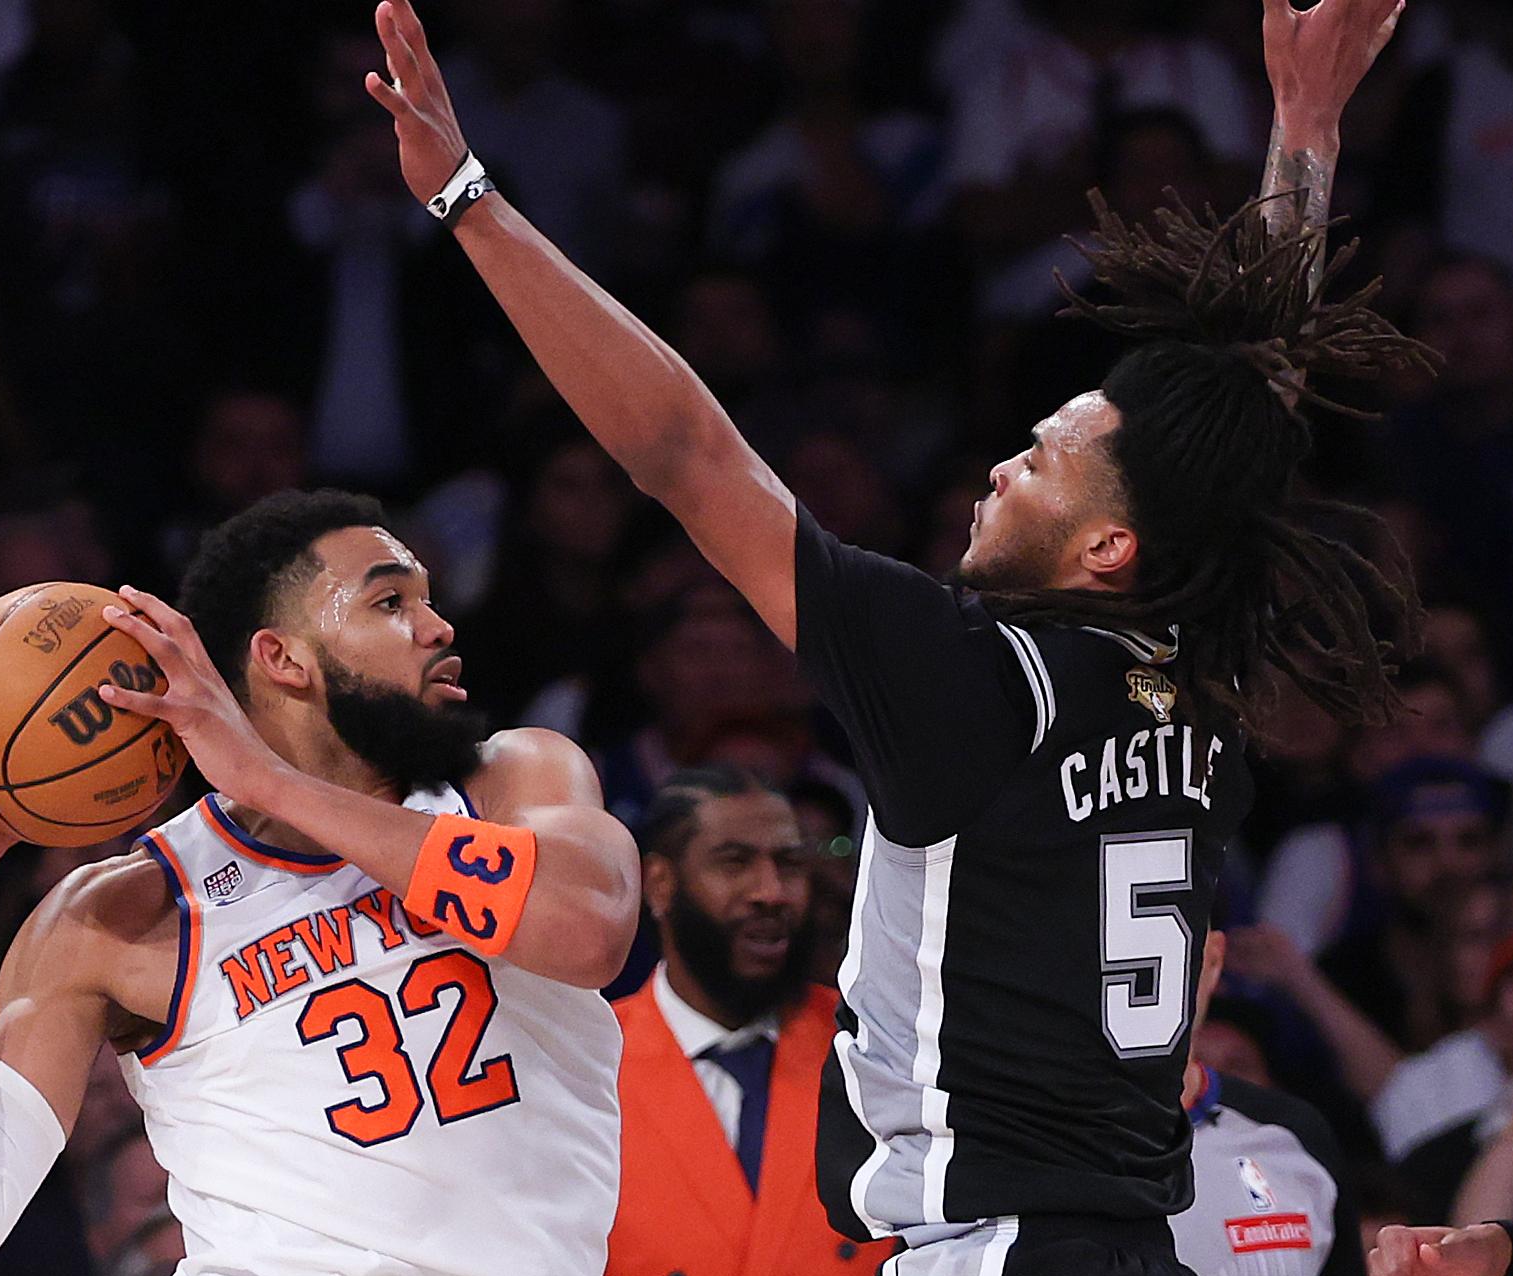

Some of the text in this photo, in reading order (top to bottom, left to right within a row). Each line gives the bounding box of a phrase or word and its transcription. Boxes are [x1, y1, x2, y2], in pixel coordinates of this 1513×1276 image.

[219, 905, 356, 1021] NEW
[433, 835, 514, 939] 32
[1099, 827, 1194, 1060] 5
[296, 948, 520, 1147] 32
